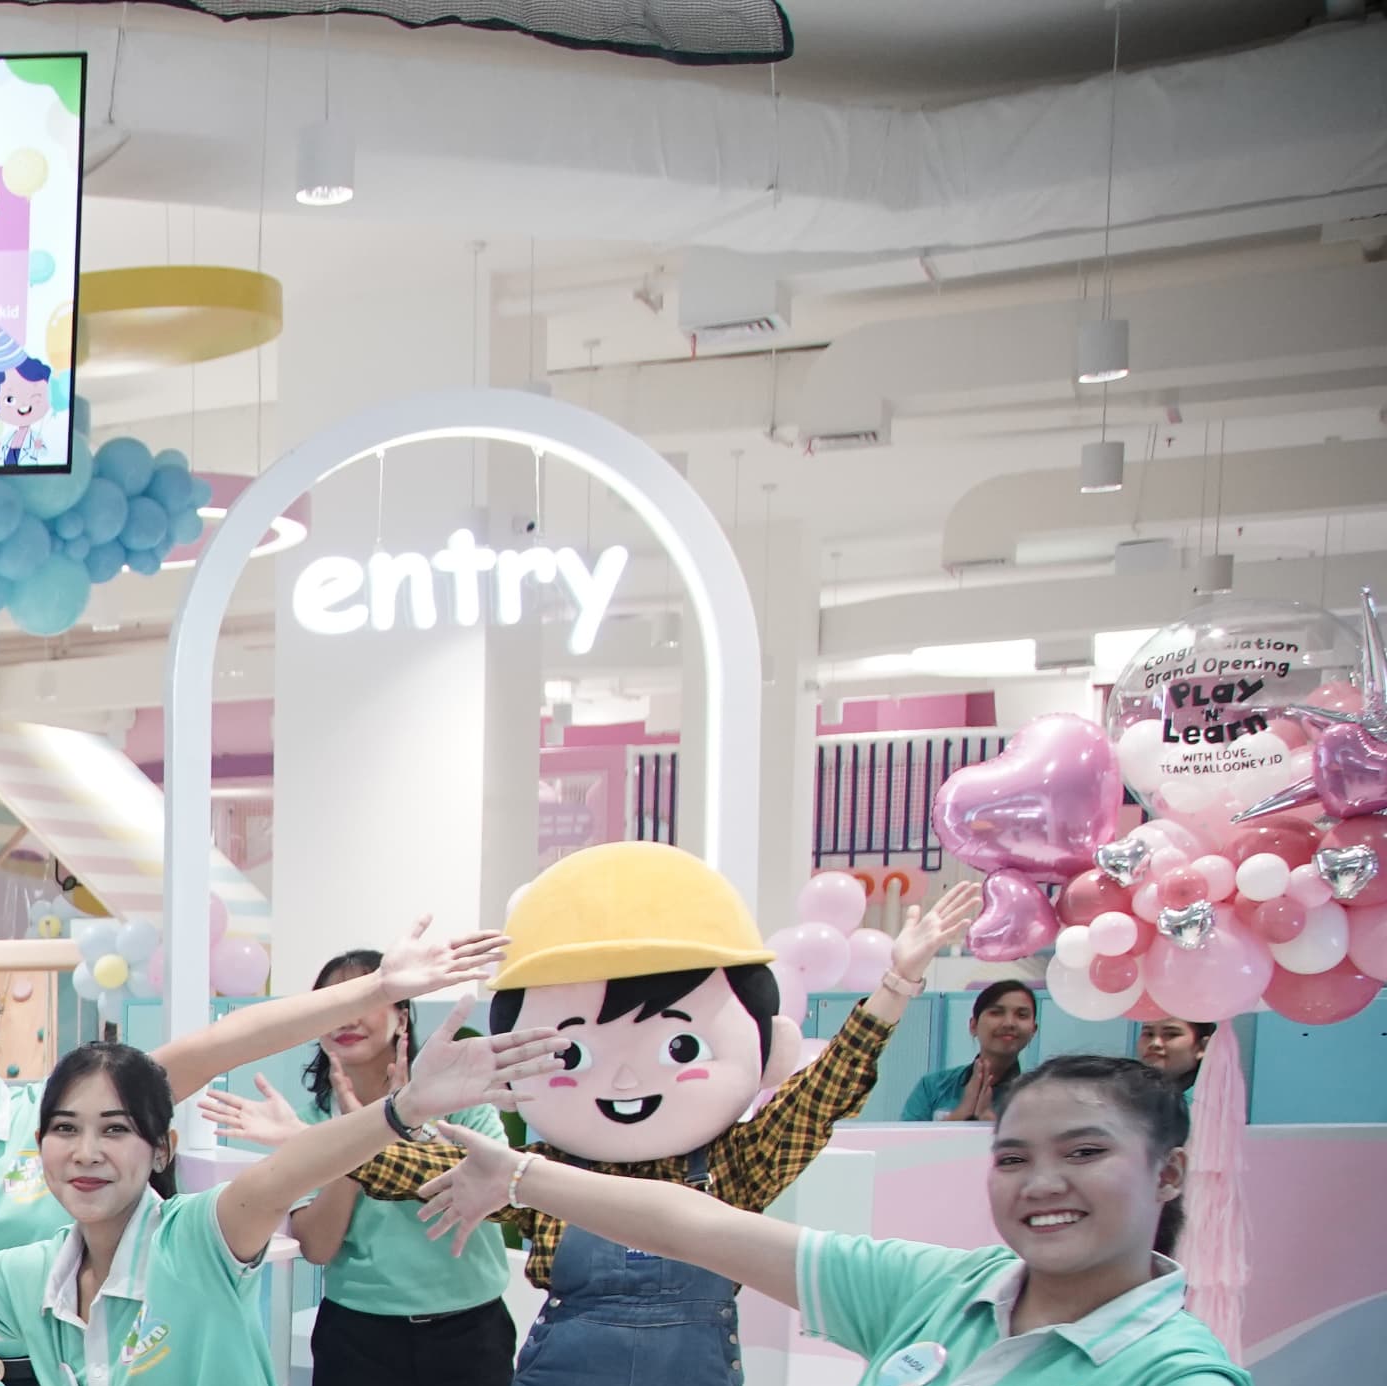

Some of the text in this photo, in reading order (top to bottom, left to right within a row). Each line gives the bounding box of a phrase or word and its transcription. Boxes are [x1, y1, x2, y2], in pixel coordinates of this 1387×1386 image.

[292, 528, 628, 655] entry
[1145, 657, 1290, 689] Grand Opening
[1163, 713, 1268, 745] Learn
[1161, 764, 1190, 774] TEAM
[1182, 752, 1213, 763] WITH
